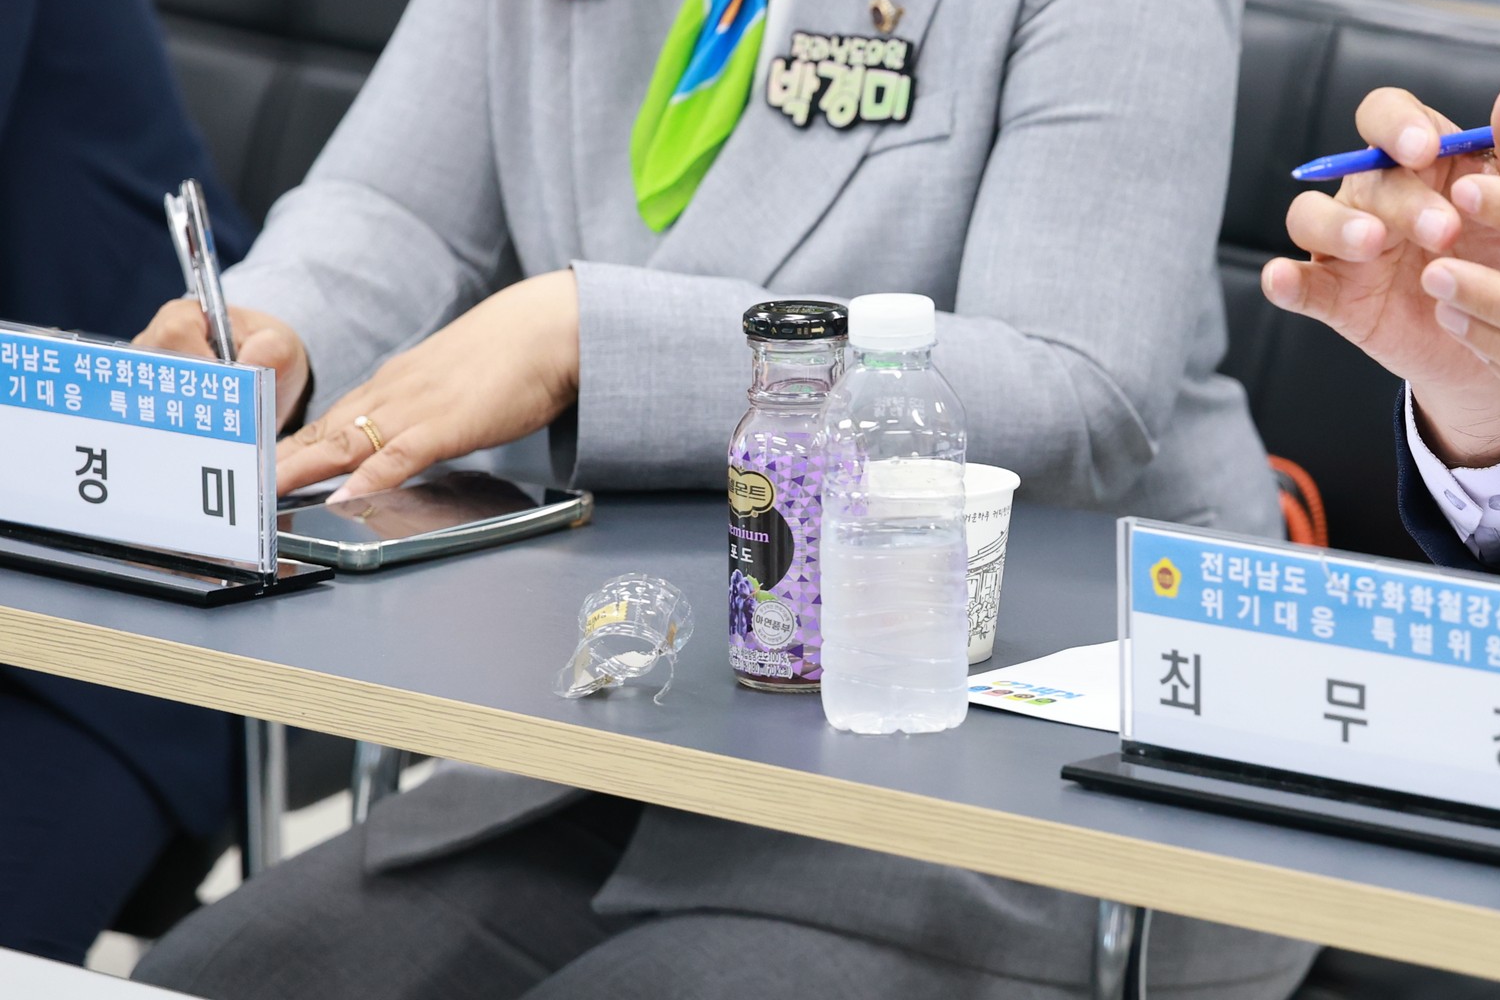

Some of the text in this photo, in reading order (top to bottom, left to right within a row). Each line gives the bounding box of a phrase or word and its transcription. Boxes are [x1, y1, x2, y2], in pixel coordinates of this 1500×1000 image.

[768, 58, 912, 129] 박경미
[1, 342, 240, 404] 라남도 석유화학철강산업
[9, 375, 241, 436] 기대응 특별위원회
[730, 543, 754, 563] 포도
[1200, 551, 1307, 595] 전라남도
[755, 614, 791, 633] 아연풍부
[1201, 589, 1335, 640] 위기대응
